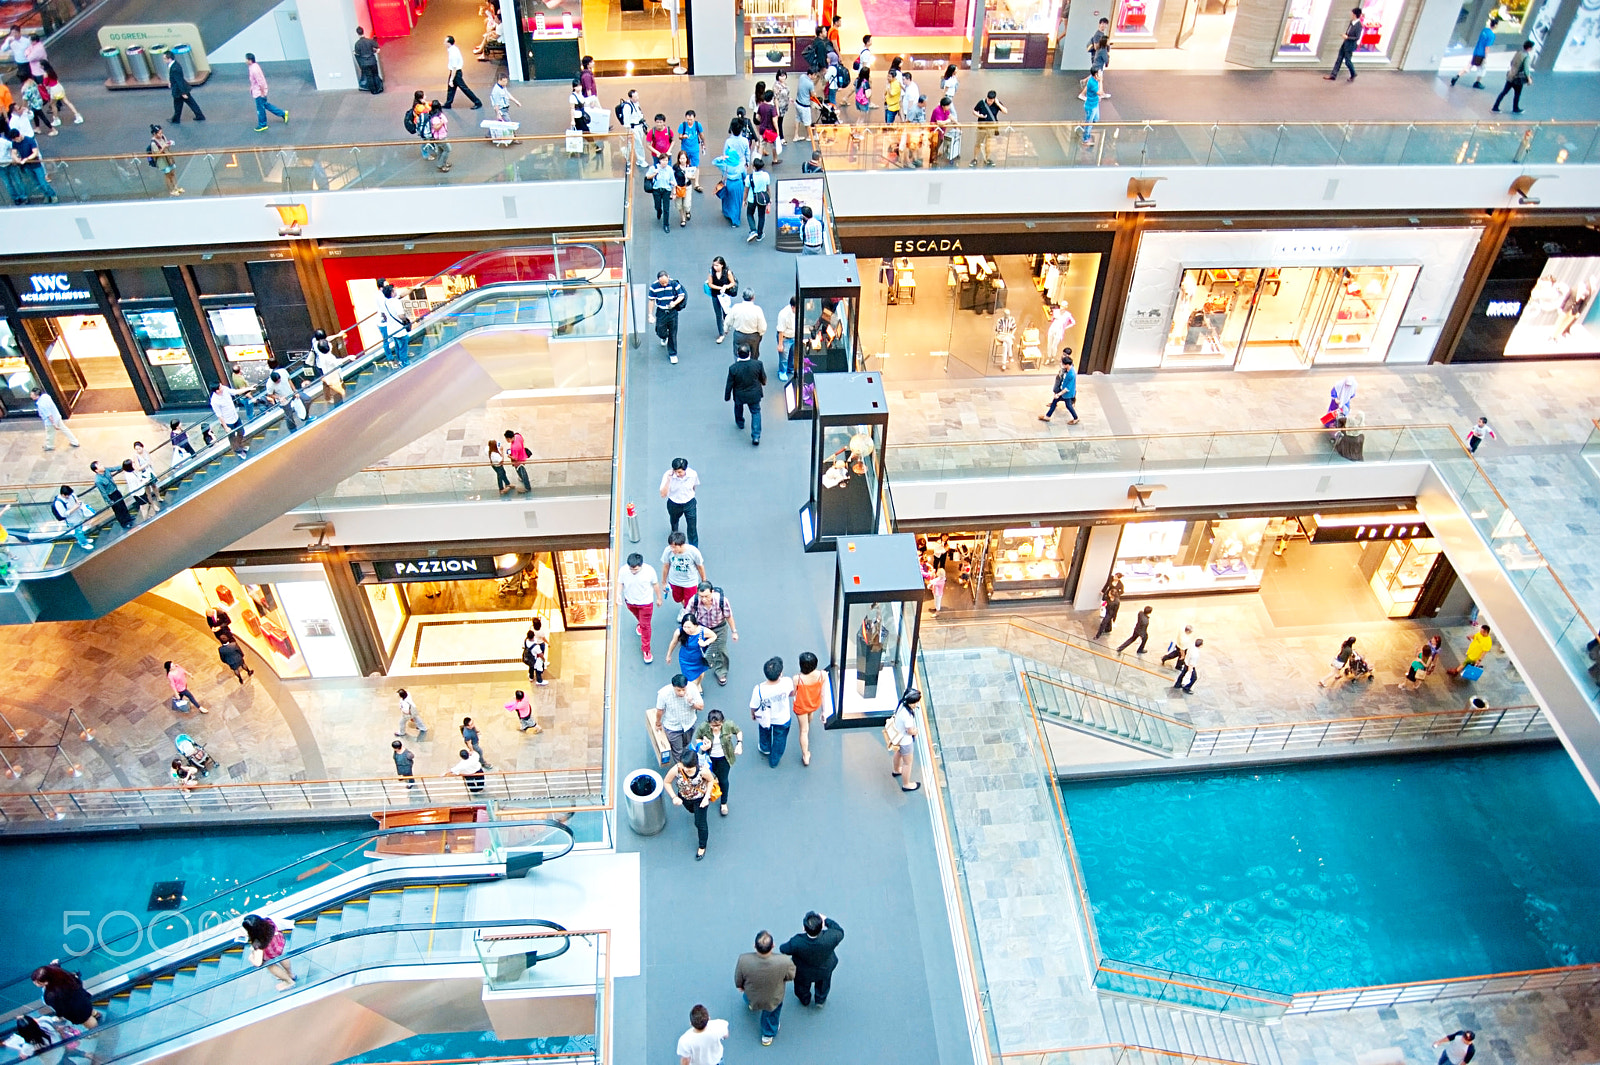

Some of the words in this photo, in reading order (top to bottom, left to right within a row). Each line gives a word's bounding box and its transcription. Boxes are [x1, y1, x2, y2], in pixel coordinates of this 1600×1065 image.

[110, 33, 121, 41] GO
[121, 32, 147, 40] GREEN
[894, 239, 963, 253] ESCADA
[29, 274, 71, 292] IWC
[395, 559, 478, 575] PAZZION
